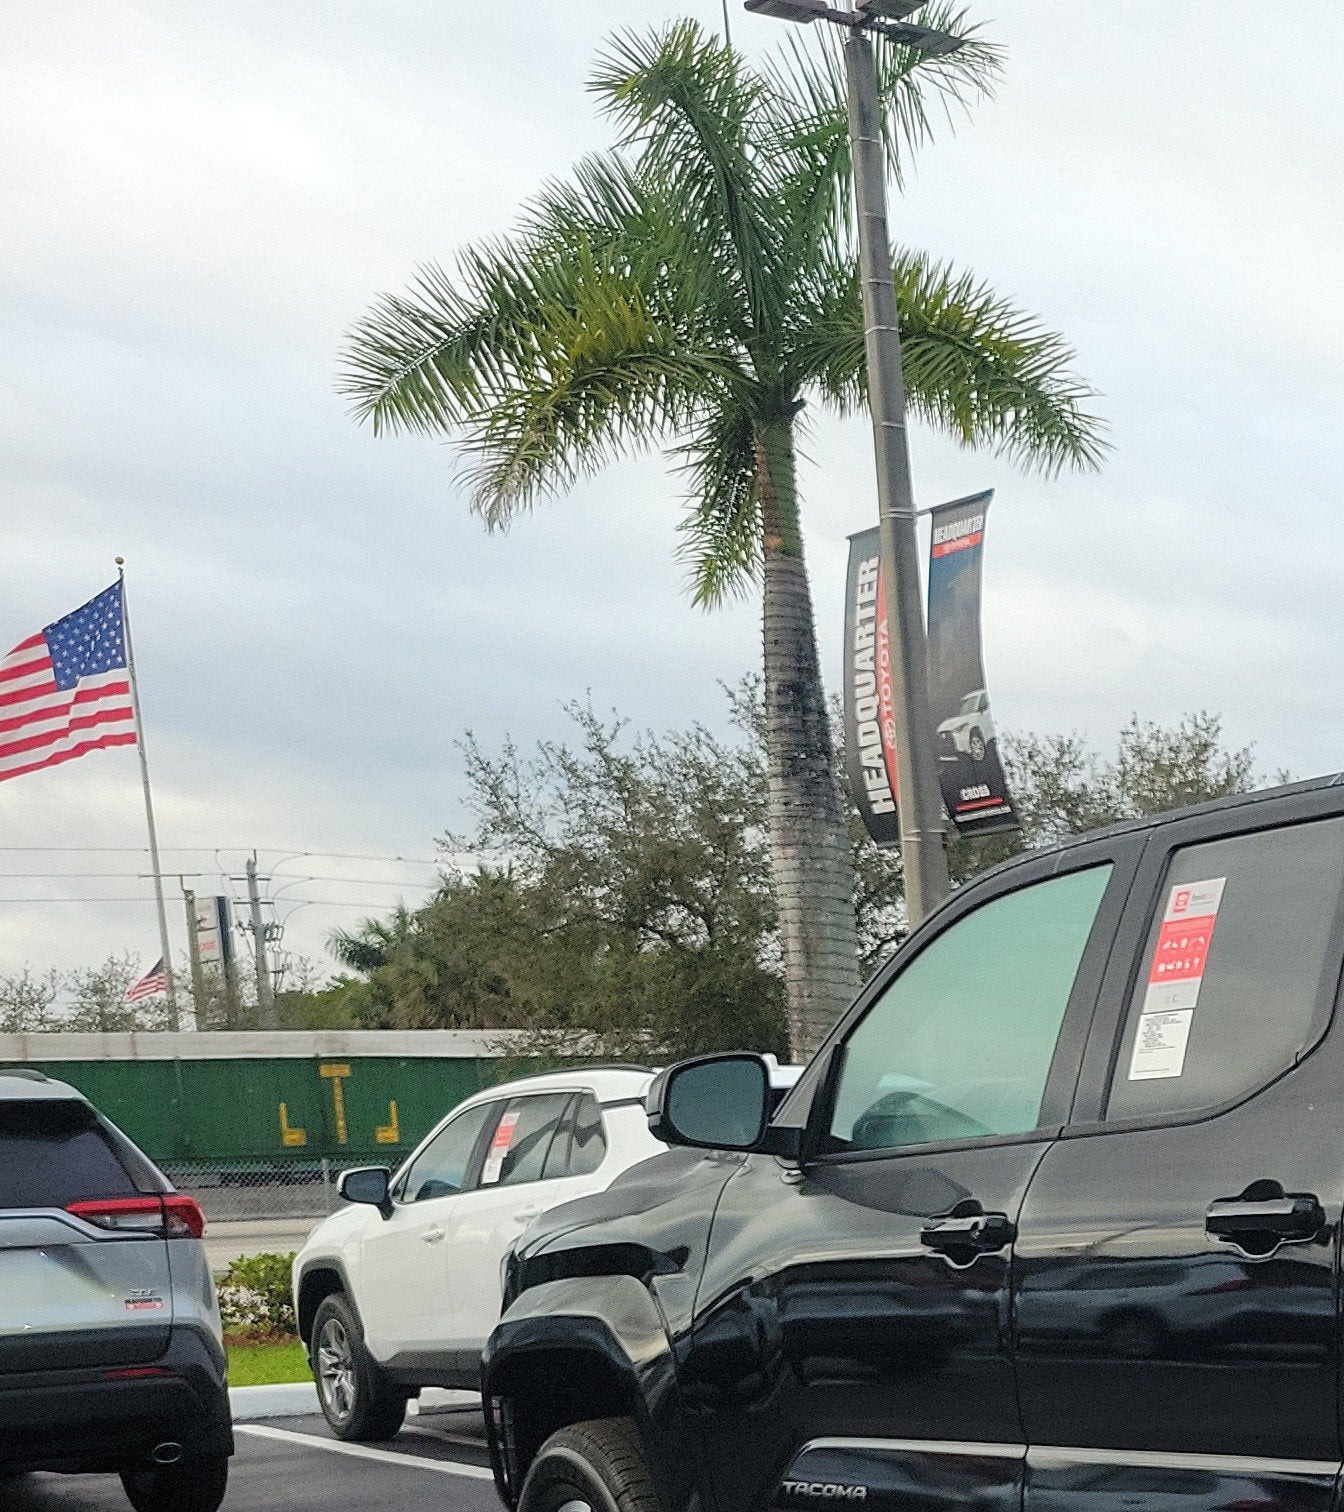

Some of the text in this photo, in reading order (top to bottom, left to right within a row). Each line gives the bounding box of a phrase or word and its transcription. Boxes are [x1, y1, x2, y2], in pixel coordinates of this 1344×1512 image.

[854, 555, 896, 815] HEADQUARTER
[877, 617, 893, 719] TOYOTA
[782, 1480, 868, 1500] TACOMA
